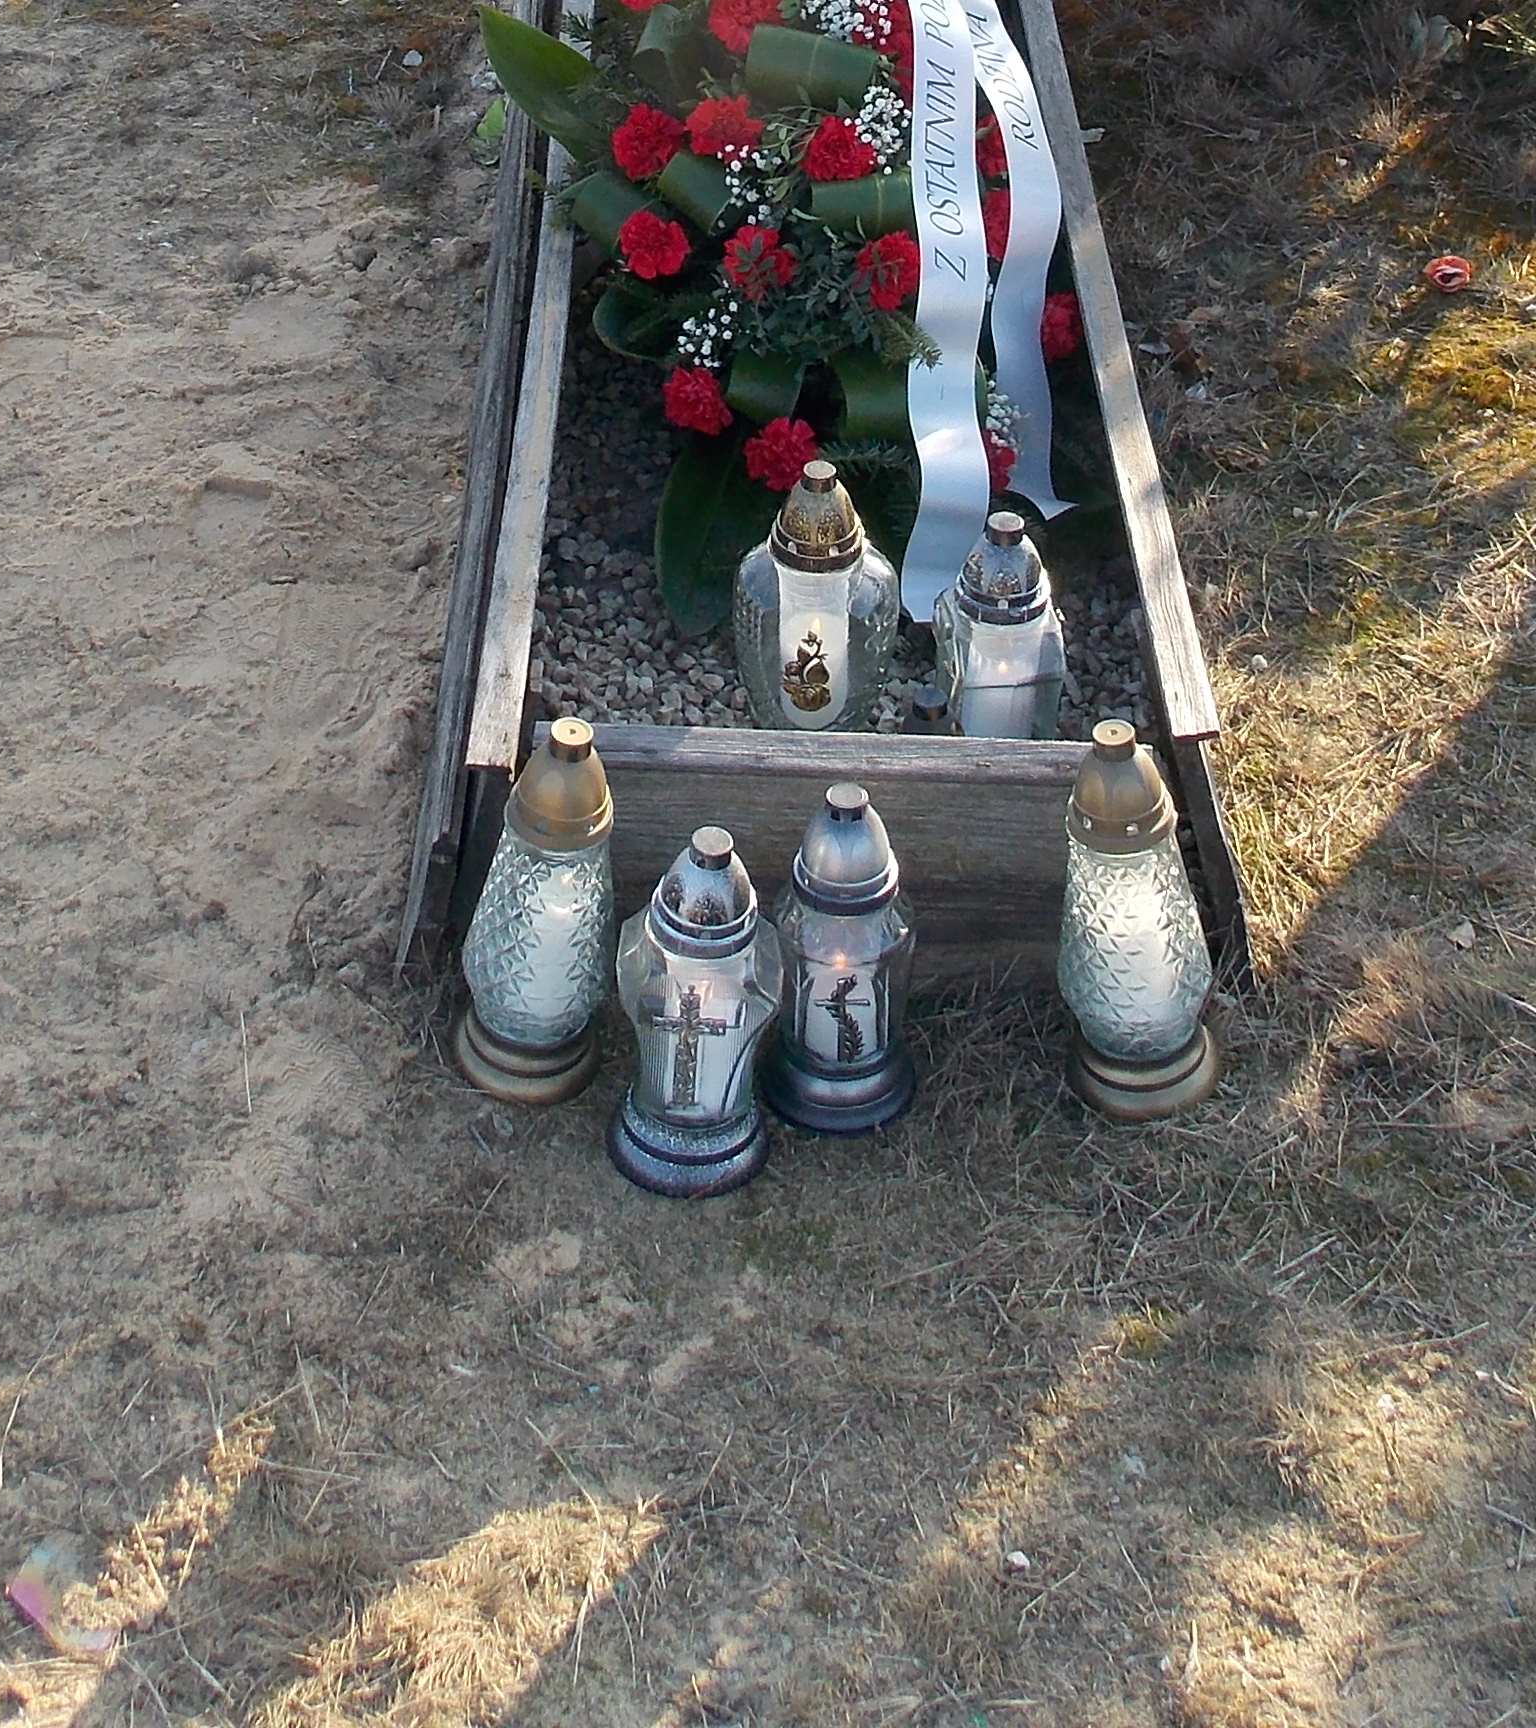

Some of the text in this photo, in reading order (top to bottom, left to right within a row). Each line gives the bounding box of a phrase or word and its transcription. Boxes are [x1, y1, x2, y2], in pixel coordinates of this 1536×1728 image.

[921, 58, 966, 237] OSTATNIM
[966, 11, 1041, 151] RODZINA
[934, 249, 967, 282] Z
